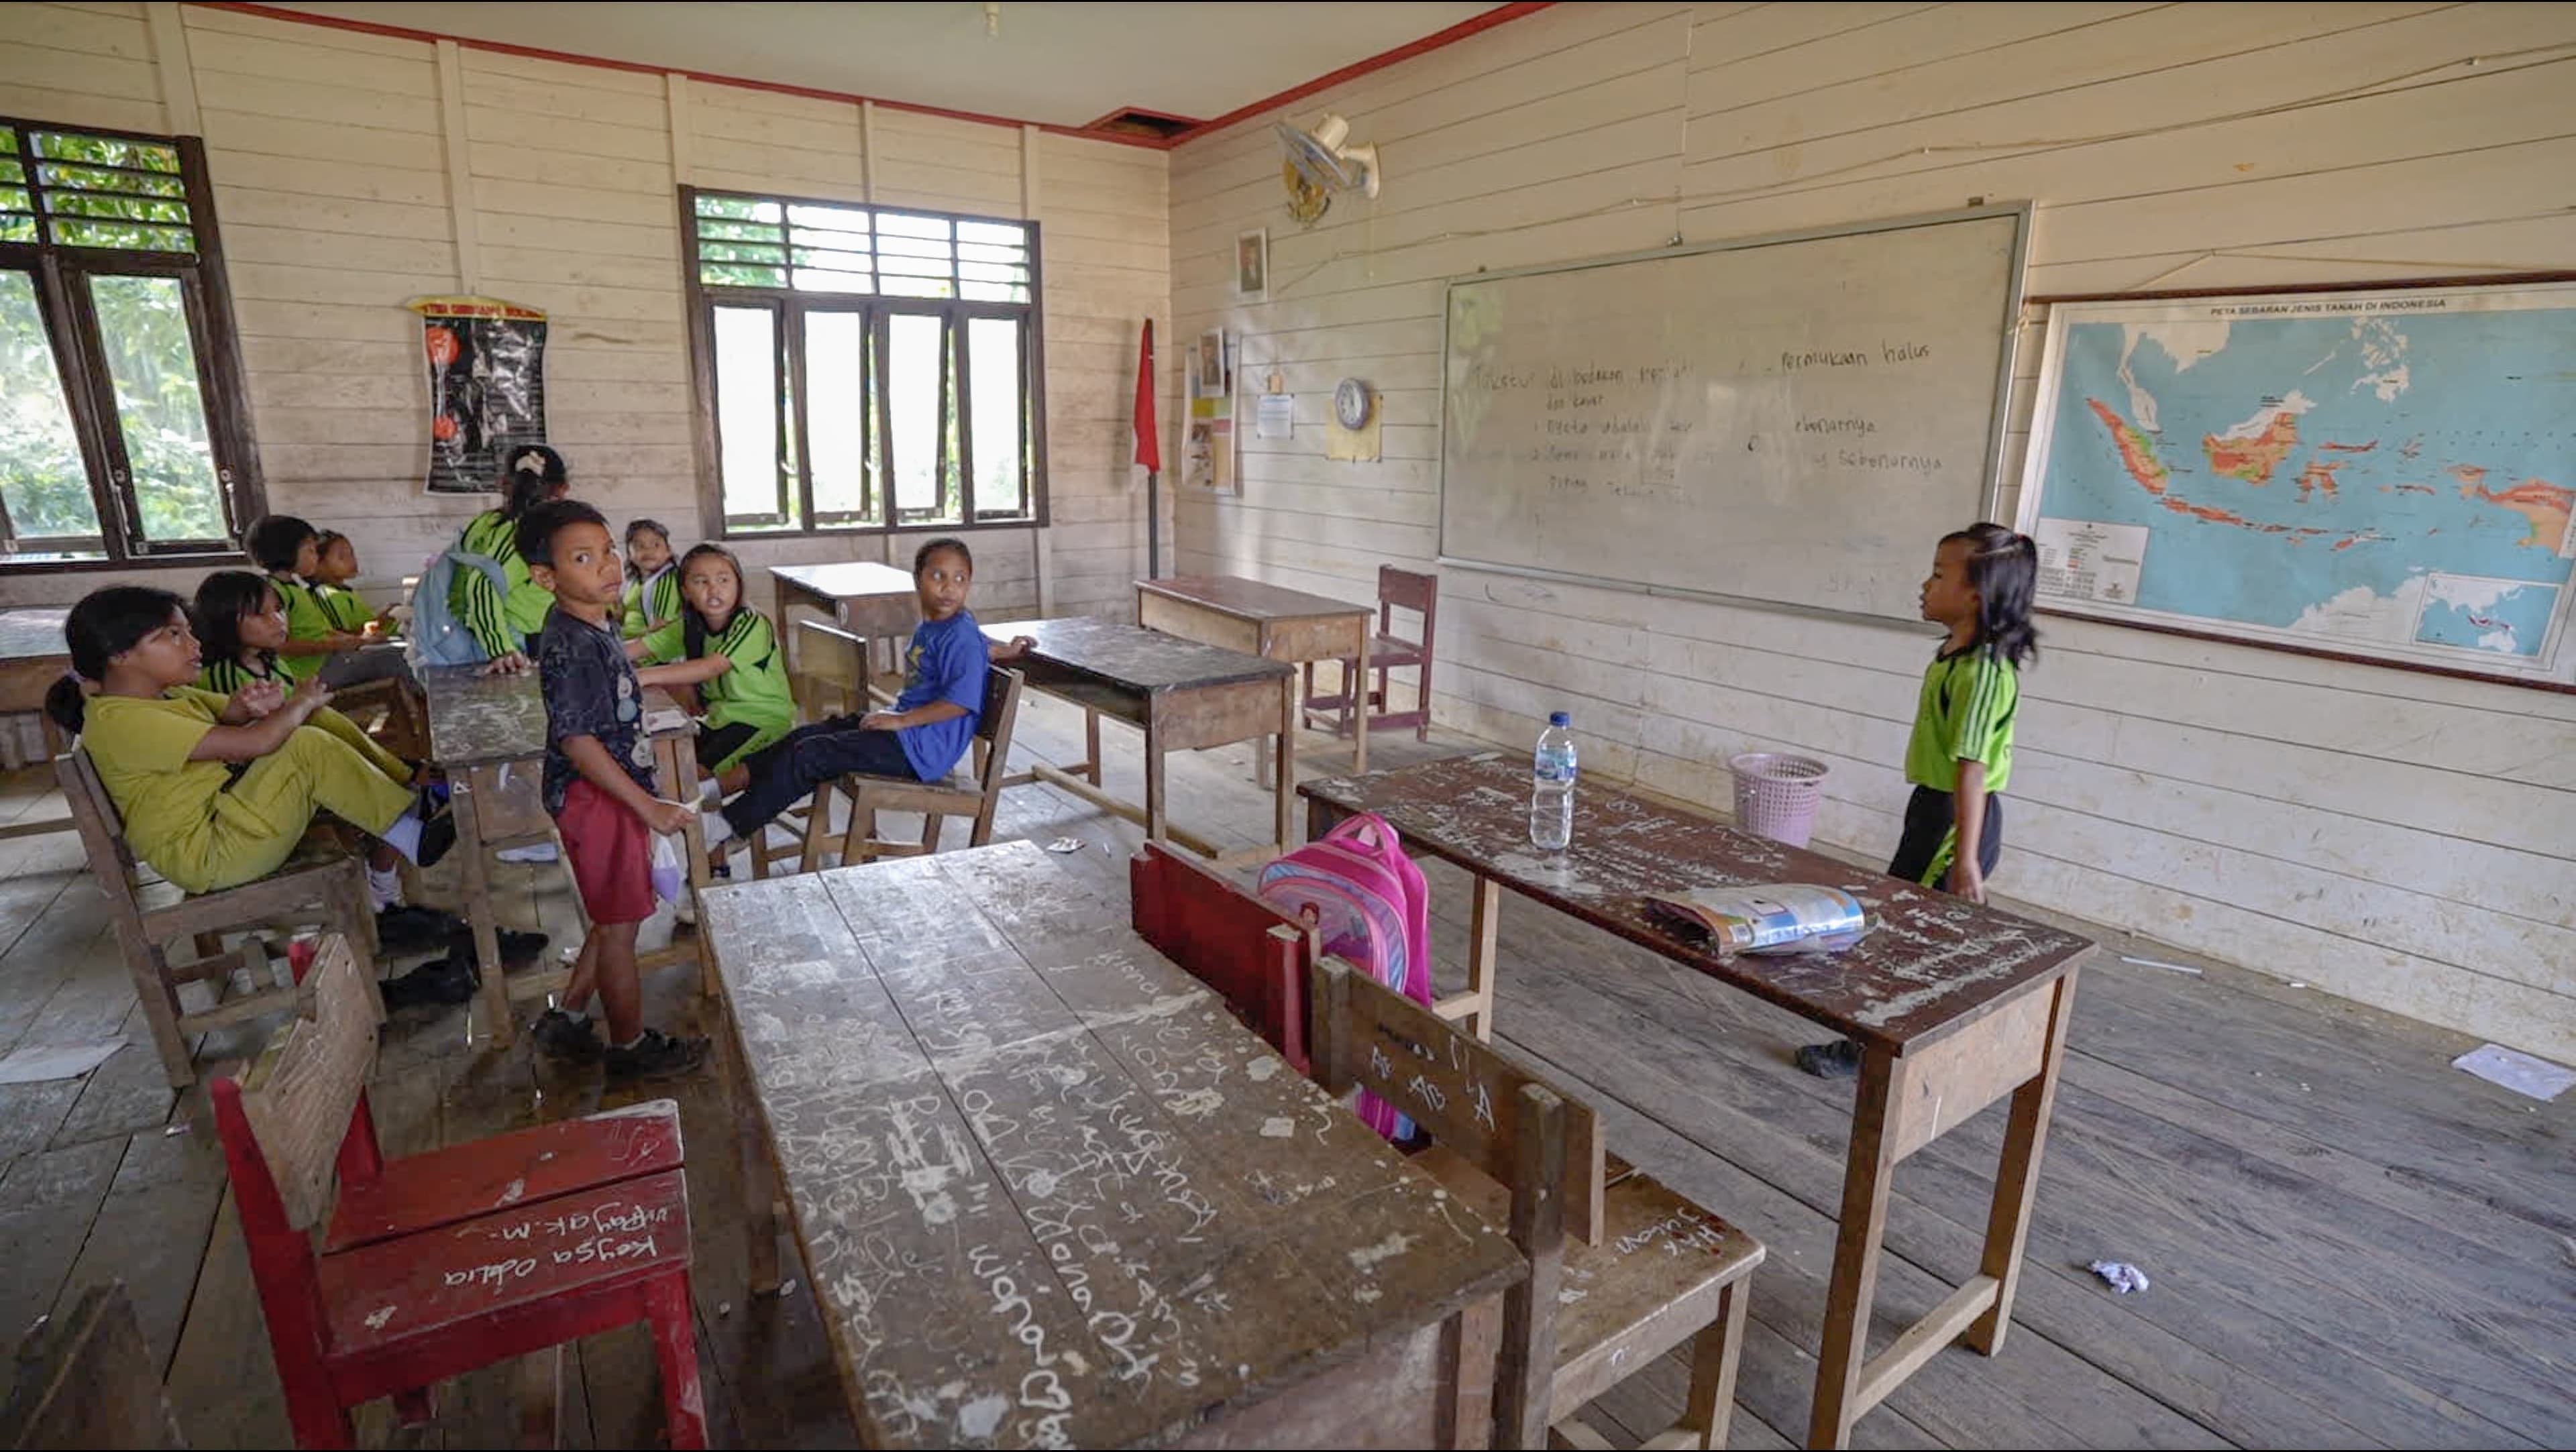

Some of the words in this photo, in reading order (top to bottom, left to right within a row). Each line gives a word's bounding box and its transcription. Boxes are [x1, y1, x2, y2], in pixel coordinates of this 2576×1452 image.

[2210, 306, 2236, 316] PETA
[2238, 304, 2288, 315] SEBARAN
[2291, 302, 2322, 314] JENIS
[2325, 302, 2362, 313] TANAH
[2365, 300, 2378, 311] DI
[2379, 297, 2446, 311] INDONESIA
[1880, 337, 1931, 364] halus
